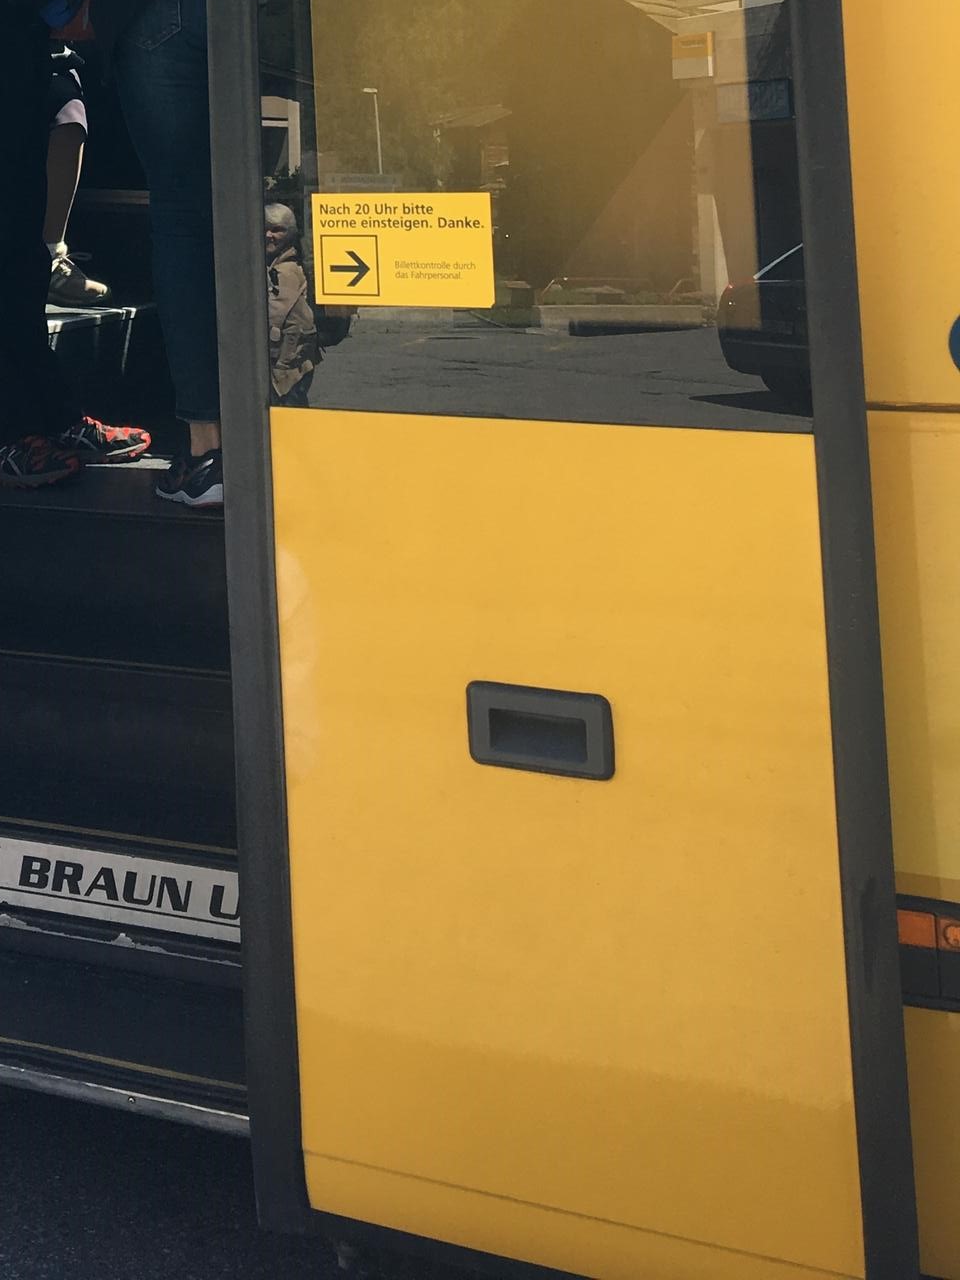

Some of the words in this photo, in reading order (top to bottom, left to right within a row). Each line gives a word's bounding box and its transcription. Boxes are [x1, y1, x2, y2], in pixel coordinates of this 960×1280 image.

[319, 203, 351, 215] Nach
[355, 203, 370, 215] 20
[374, 203, 398, 215] Uhr
[402, 203, 434, 215] bitte
[320, 219, 357, 228] vorne
[361, 217, 433, 231] einsteigen.
[438, 217, 485, 229] Danke.
[394, 260, 451, 270] Billettkontrolle
[453, 261, 477, 270] durch
[395, 271, 409, 279] das
[19, 855, 193, 913] BRAUN
